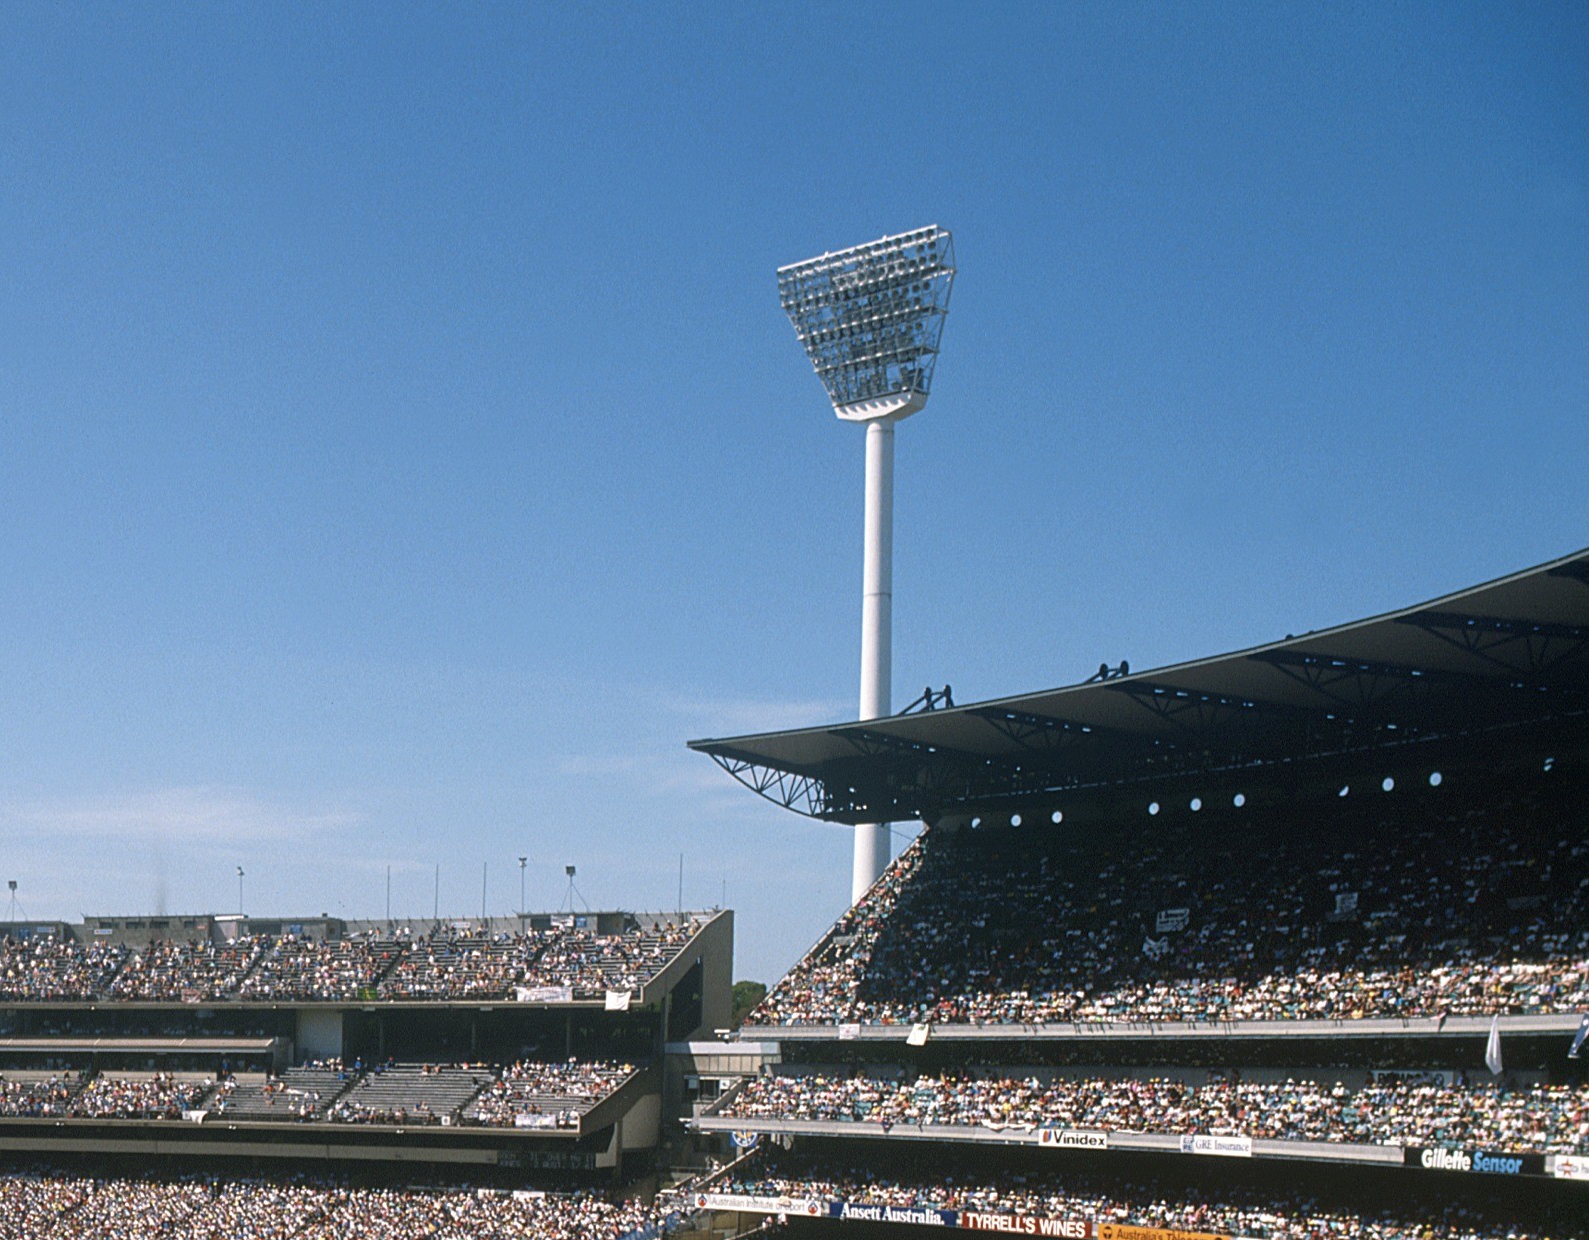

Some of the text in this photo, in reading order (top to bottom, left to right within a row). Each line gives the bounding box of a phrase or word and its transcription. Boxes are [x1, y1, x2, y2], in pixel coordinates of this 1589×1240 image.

[1054, 1130, 1105, 1146] Vinidex
[1195, 1139, 1212, 1149] GRE
[1214, 1140, 1250, 1152] Insurance
[1421, 1148, 1523, 1174] Gillette Sensor
[711, 1196, 745, 1208] Australian
[841, 1202, 945, 1225] Ansett Australia.
[966, 1212, 1086, 1238] TYRRELL'S WINES
